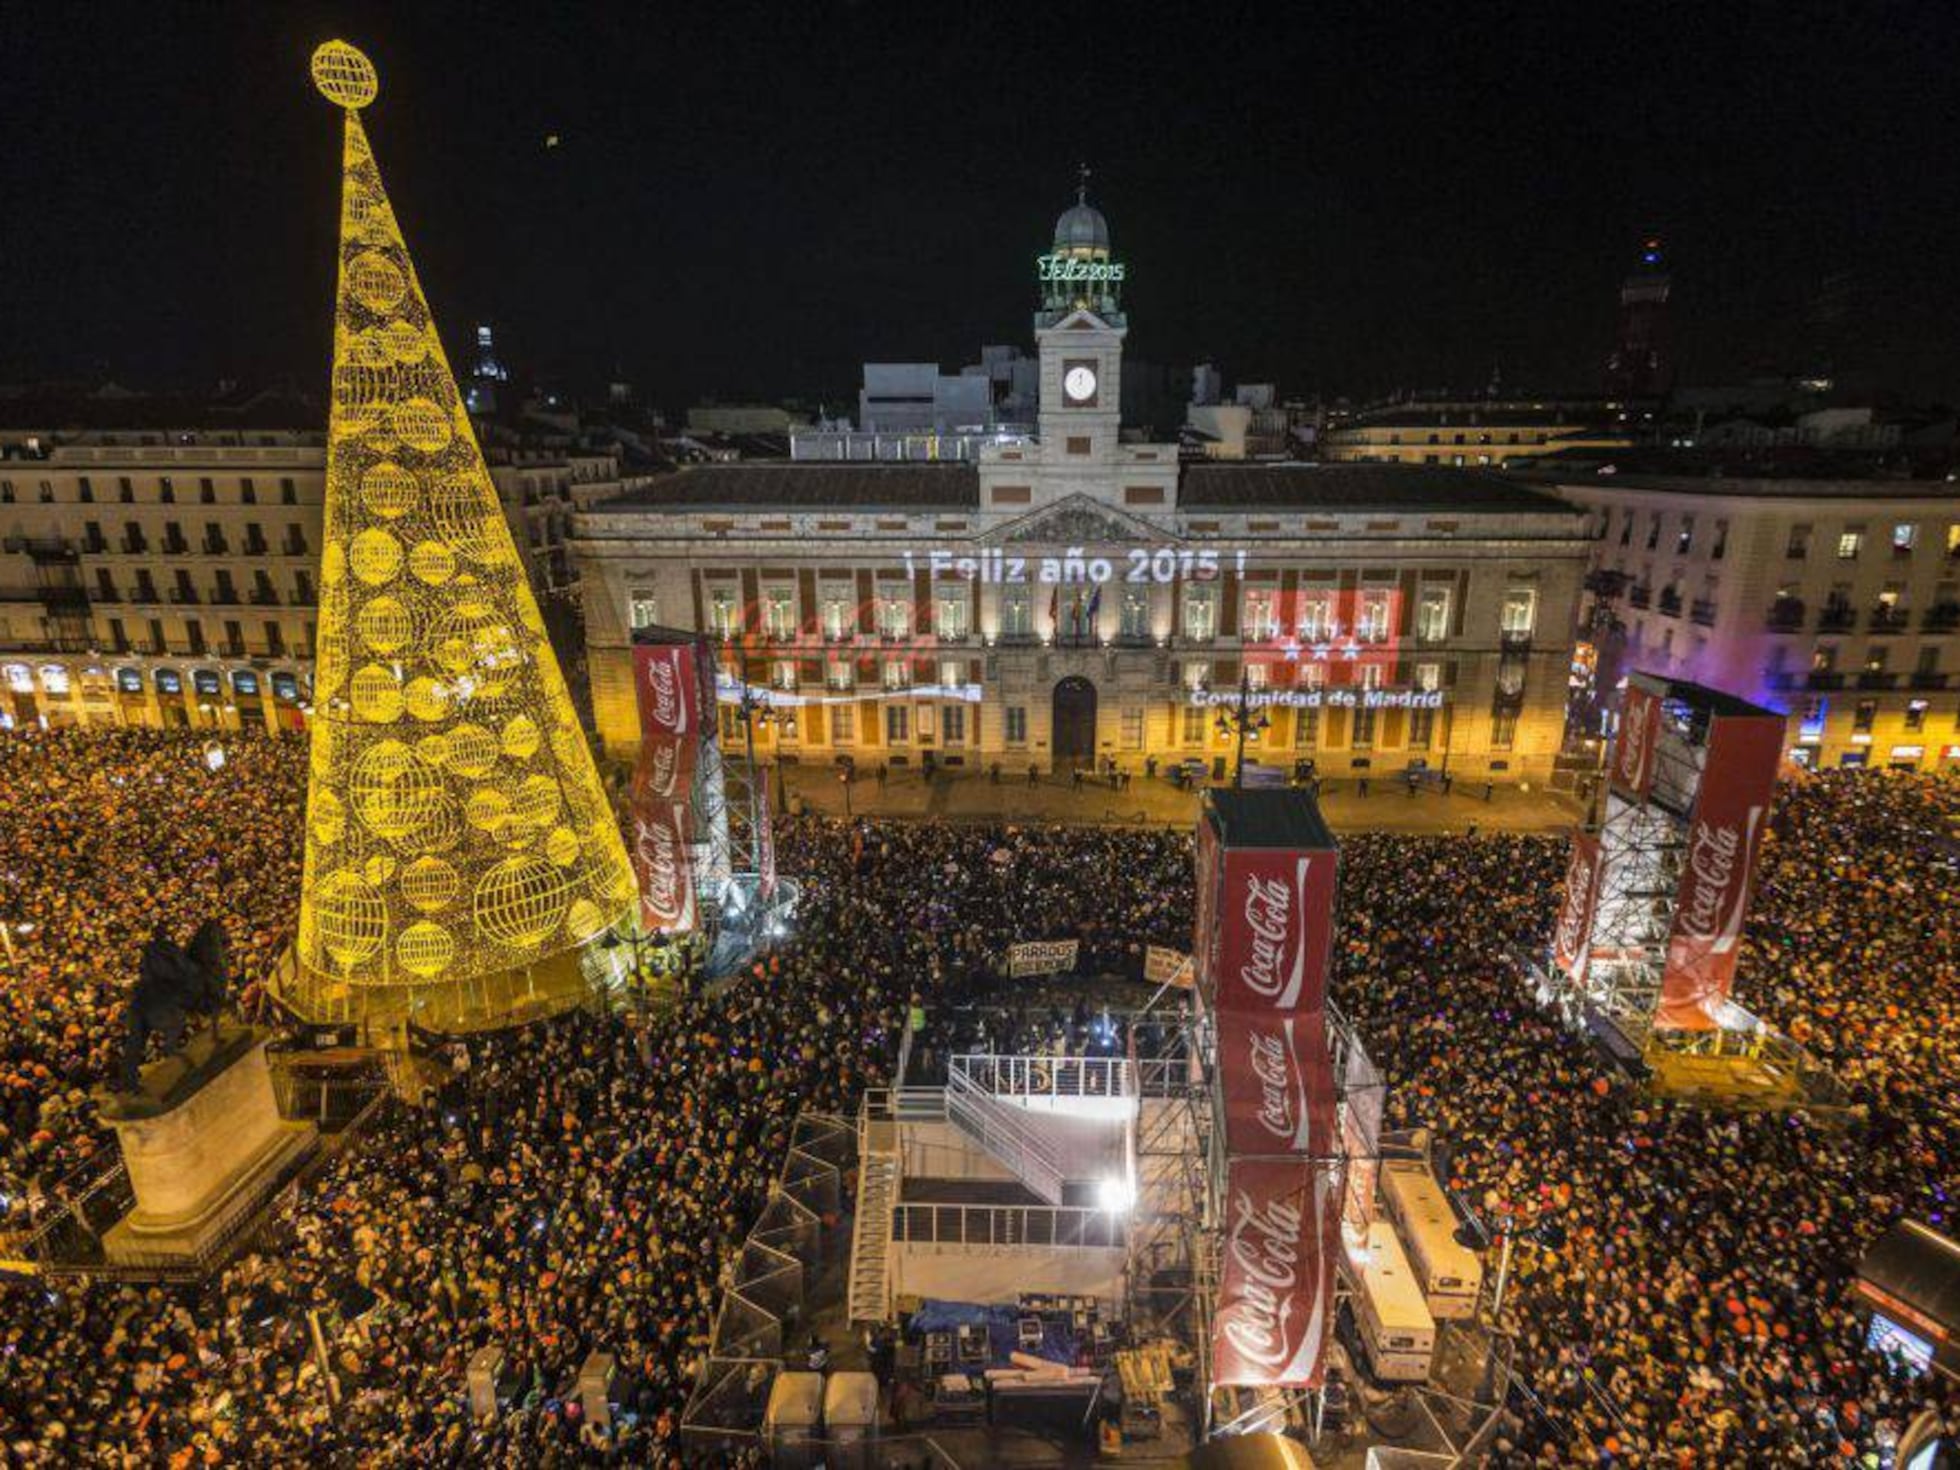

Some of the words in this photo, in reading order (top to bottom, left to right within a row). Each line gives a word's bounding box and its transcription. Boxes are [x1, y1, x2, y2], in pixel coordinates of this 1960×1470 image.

[928, 548, 1025, 584] Feliz
[1039, 546, 1113, 583] año
[1126, 548, 1219, 583] 2015
[1190, 688, 1321, 708] Comunidad
[1328, 690, 1356, 708] de
[1363, 688, 1443, 708] Madrid
